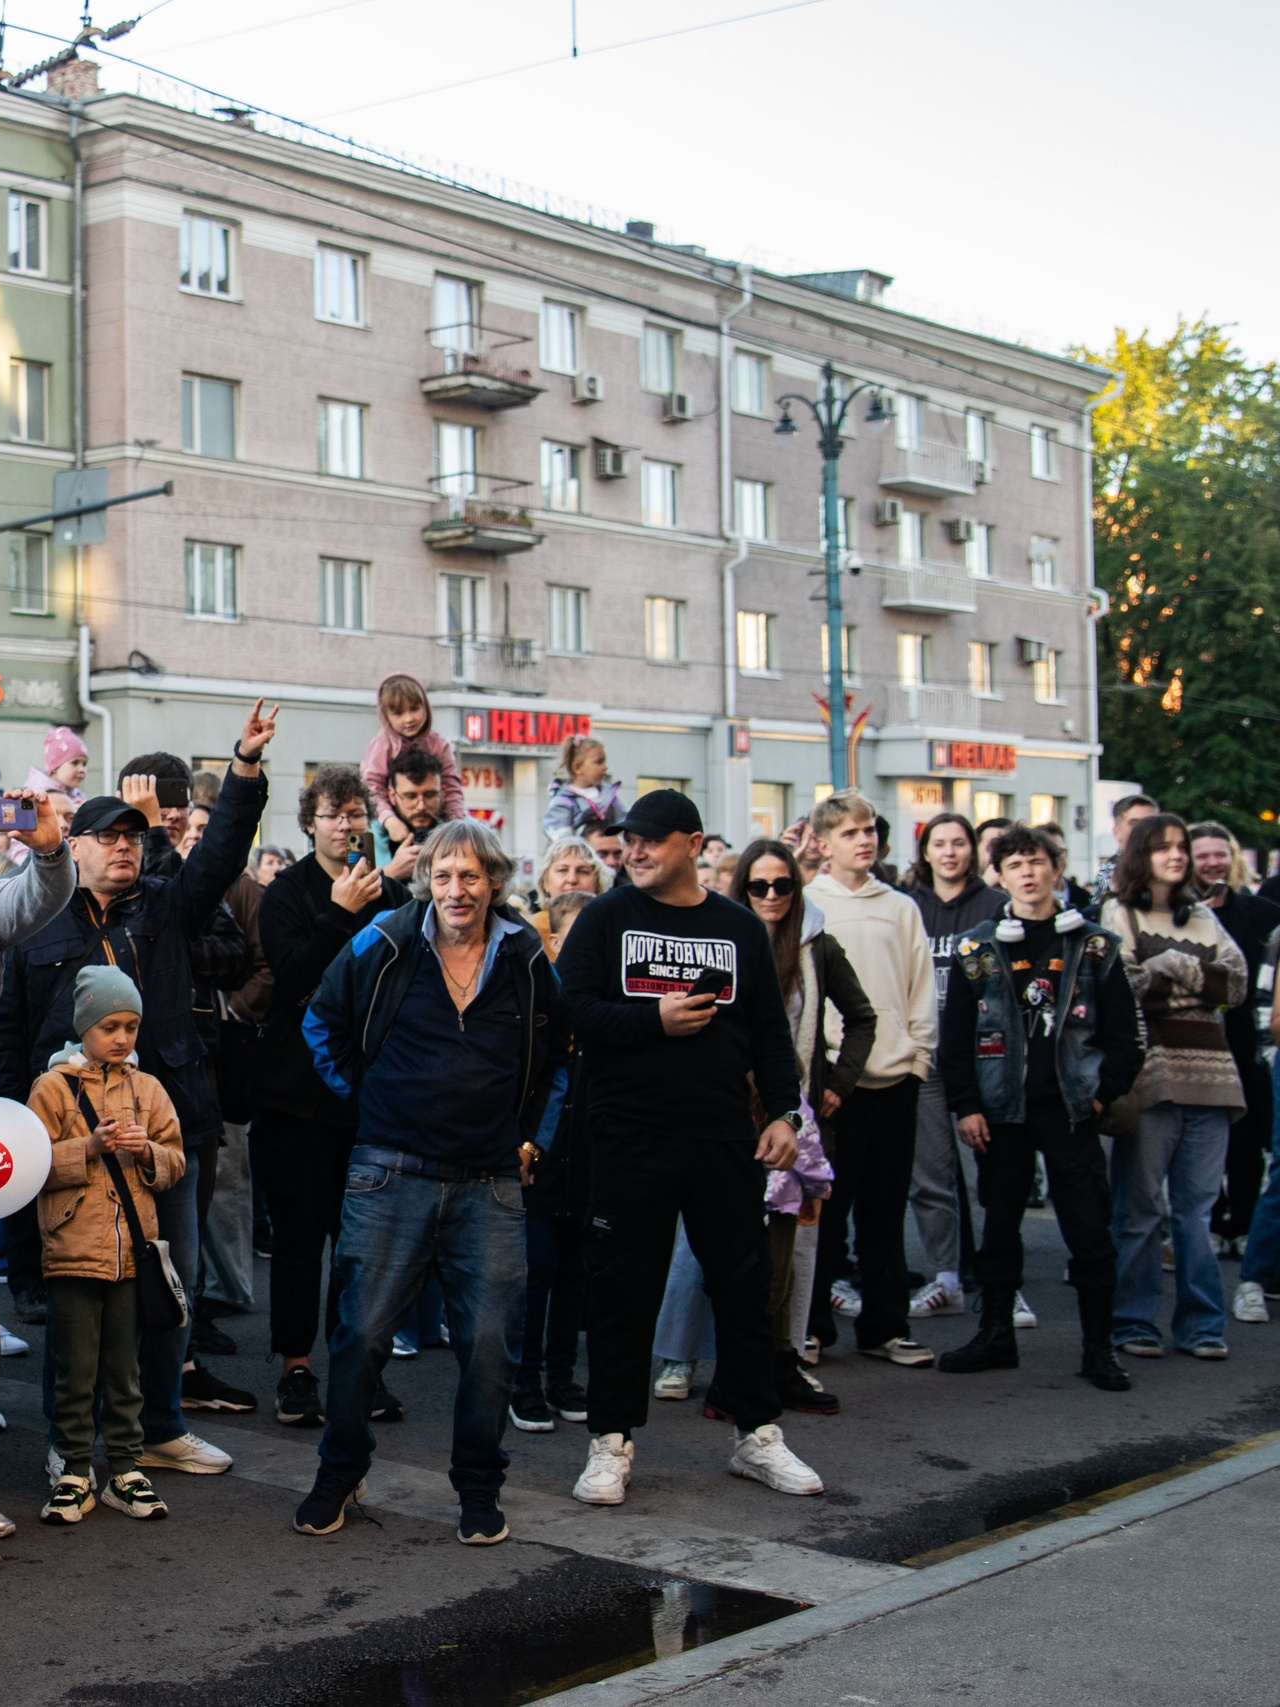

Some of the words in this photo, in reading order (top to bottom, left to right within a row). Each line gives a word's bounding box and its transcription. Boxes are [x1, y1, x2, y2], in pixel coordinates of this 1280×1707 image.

[462, 767, 503, 788] БУВЬ
[627, 935, 664, 965] MOVE
[666, 941, 733, 972] FORWARD
[649, 963, 680, 978] SINCE
[629, 981, 676, 992] DESIGNED
